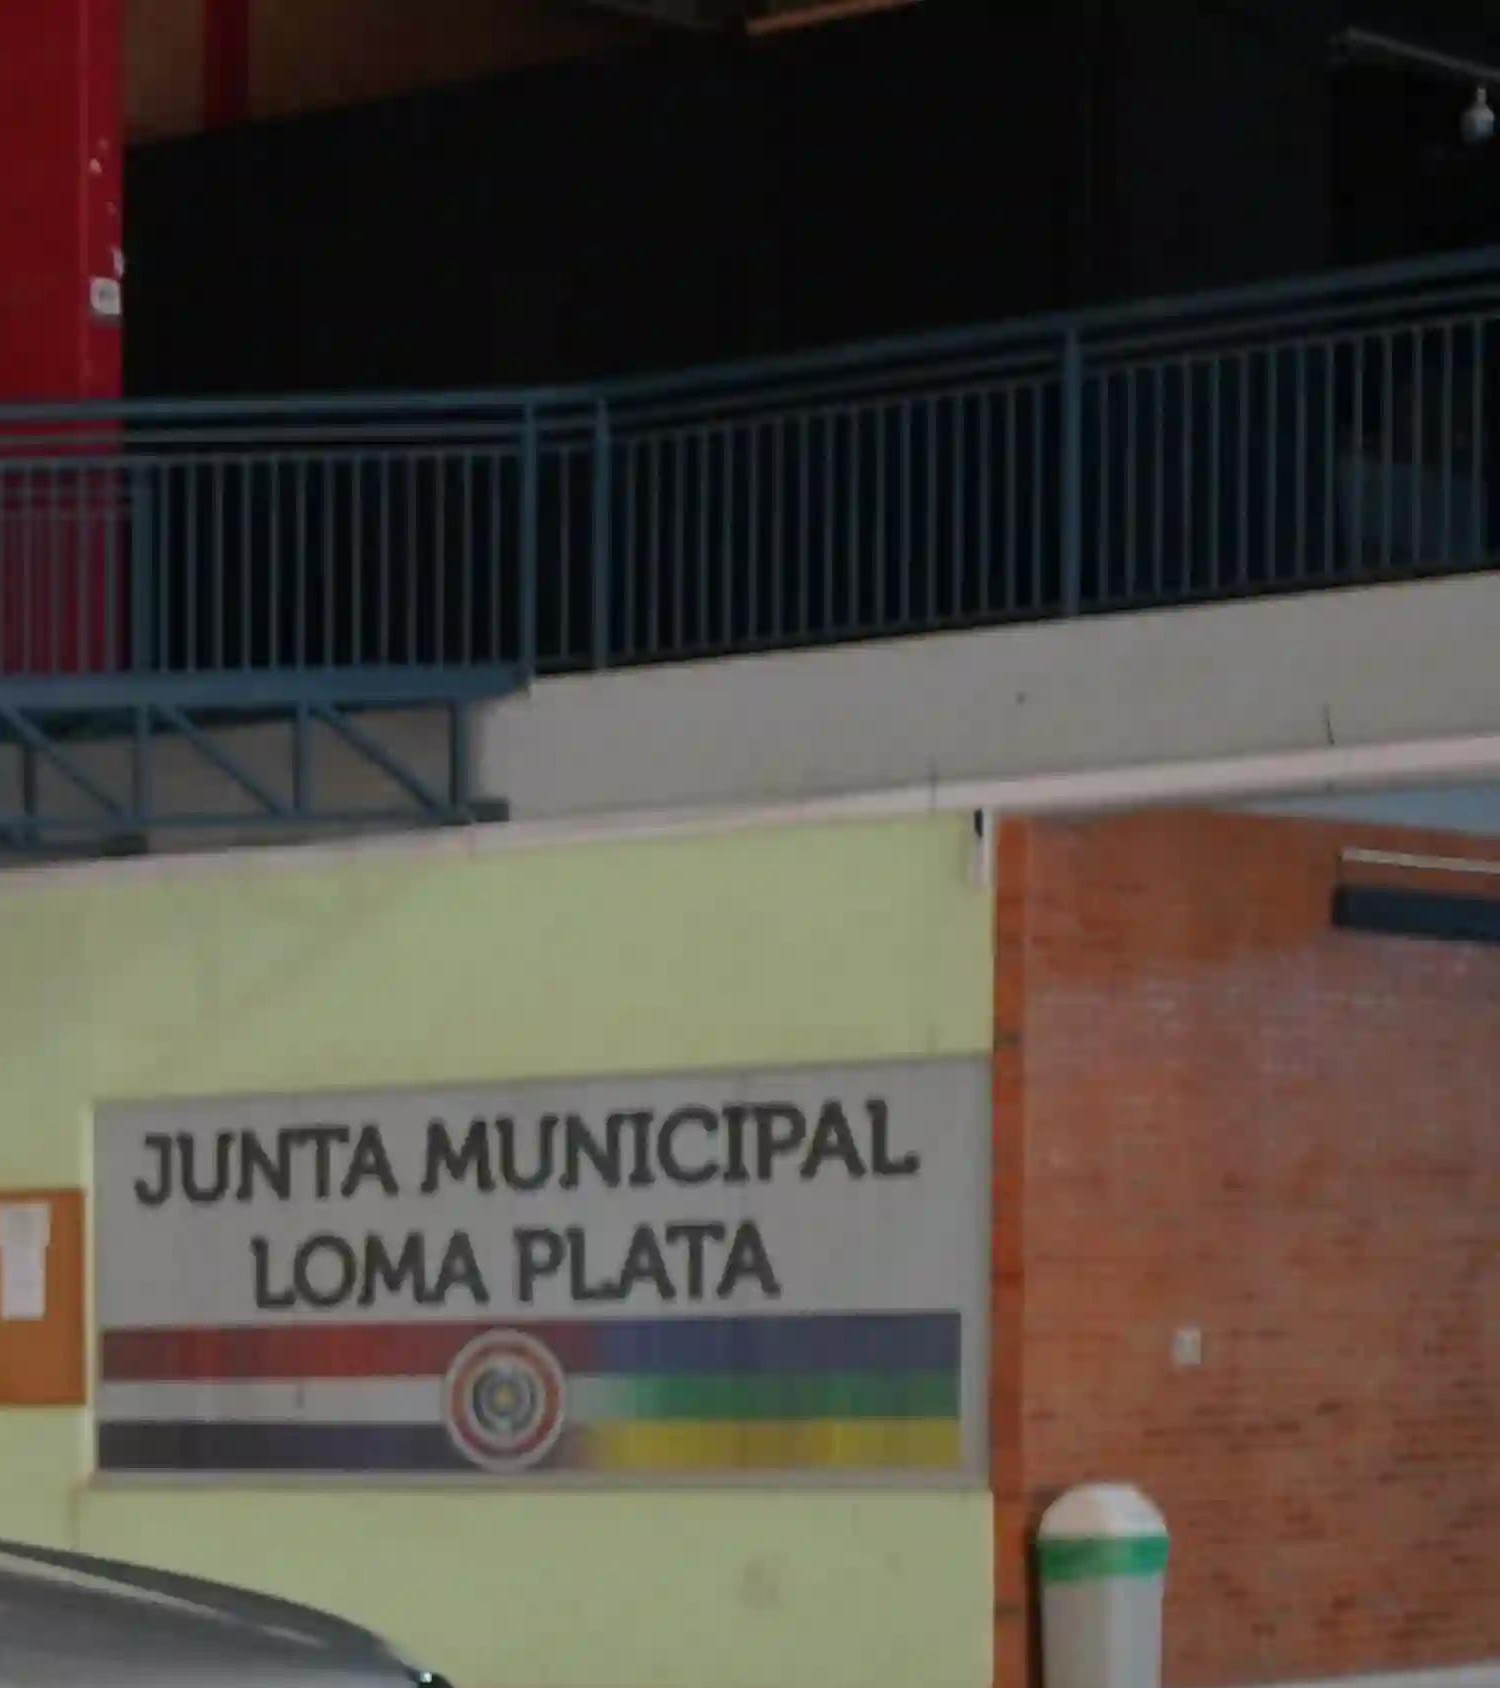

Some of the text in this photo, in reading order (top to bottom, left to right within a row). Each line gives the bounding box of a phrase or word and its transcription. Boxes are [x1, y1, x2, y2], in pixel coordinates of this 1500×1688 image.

[134, 1098, 921, 1208] JUNTA MUNICIPAL
[250, 1219, 781, 1310] LOMA PLATA
